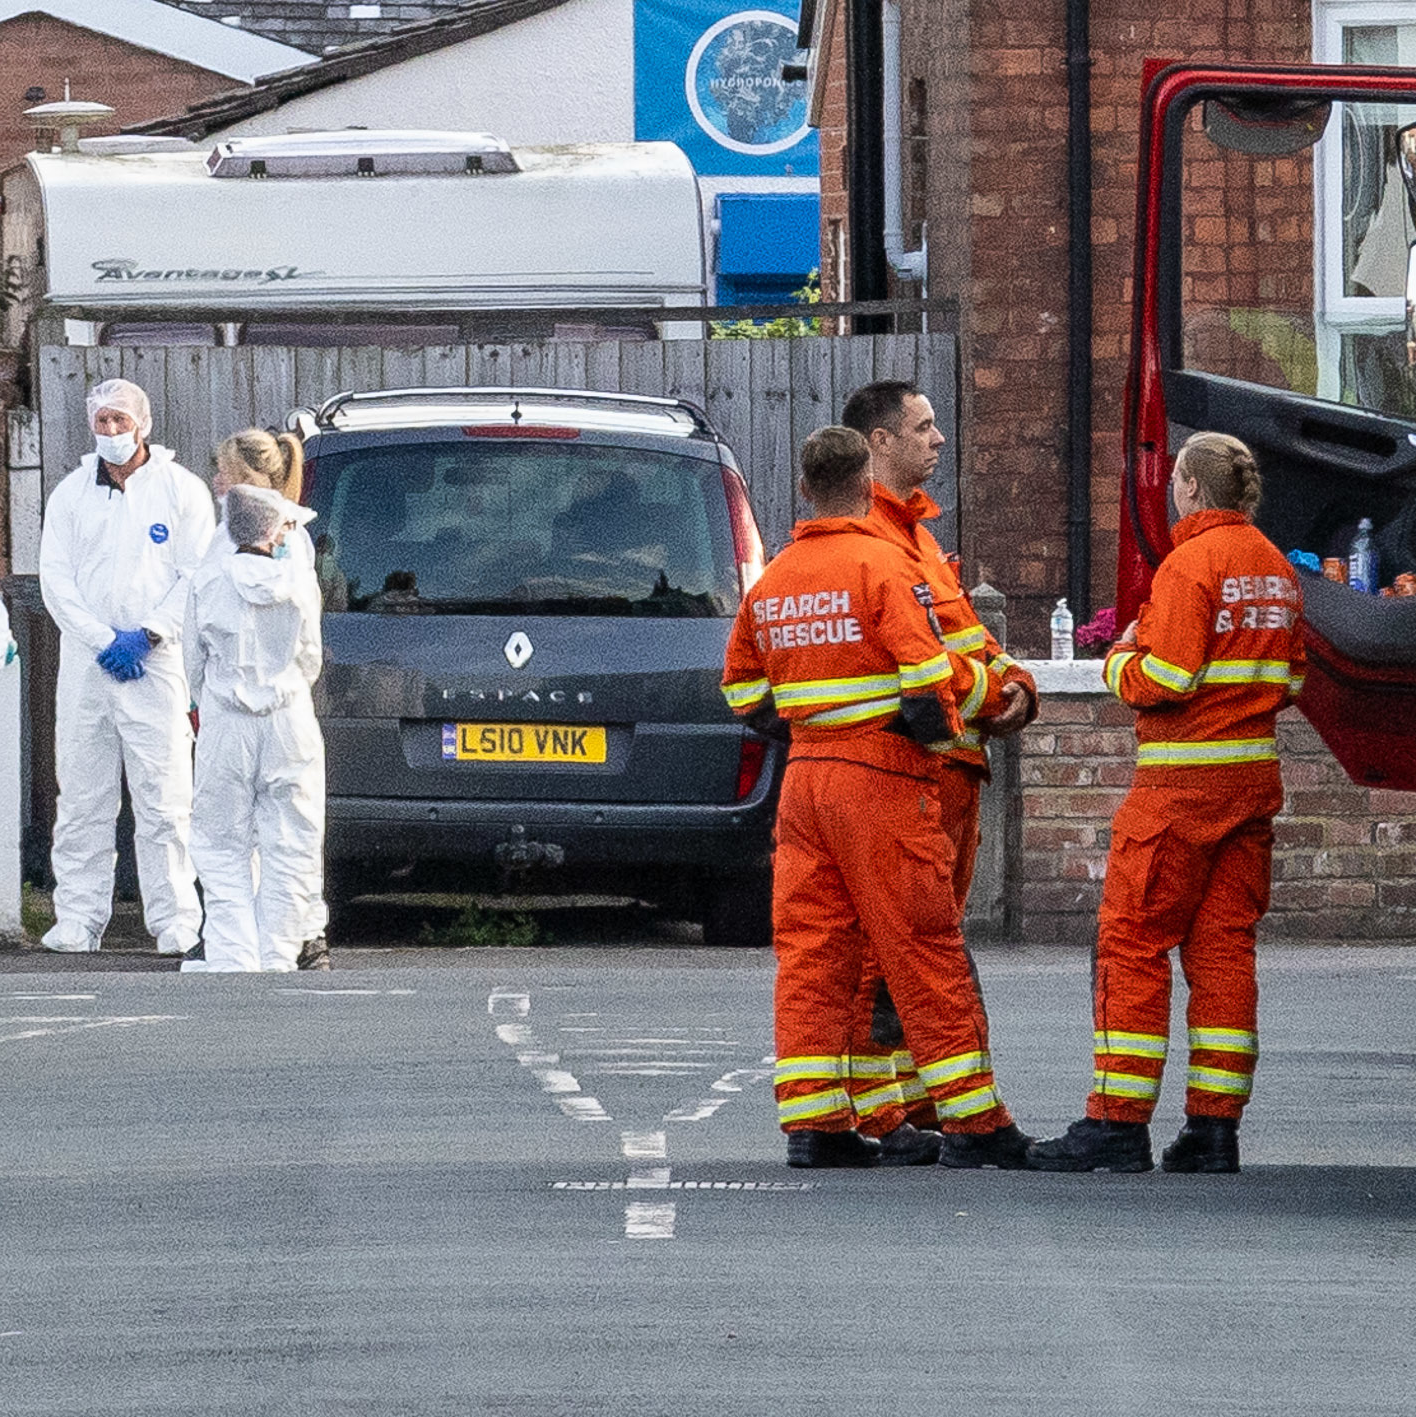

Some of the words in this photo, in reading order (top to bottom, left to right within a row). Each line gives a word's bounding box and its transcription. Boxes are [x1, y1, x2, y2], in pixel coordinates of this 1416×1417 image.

[752, 589, 852, 625] SEARCH
[1215, 609, 1235, 634] &
[769, 617, 863, 650] RESCUE
[442, 688, 594, 704] ESPACE
[461, 726, 524, 755] LS10
[533, 728, 588, 757] VNK
